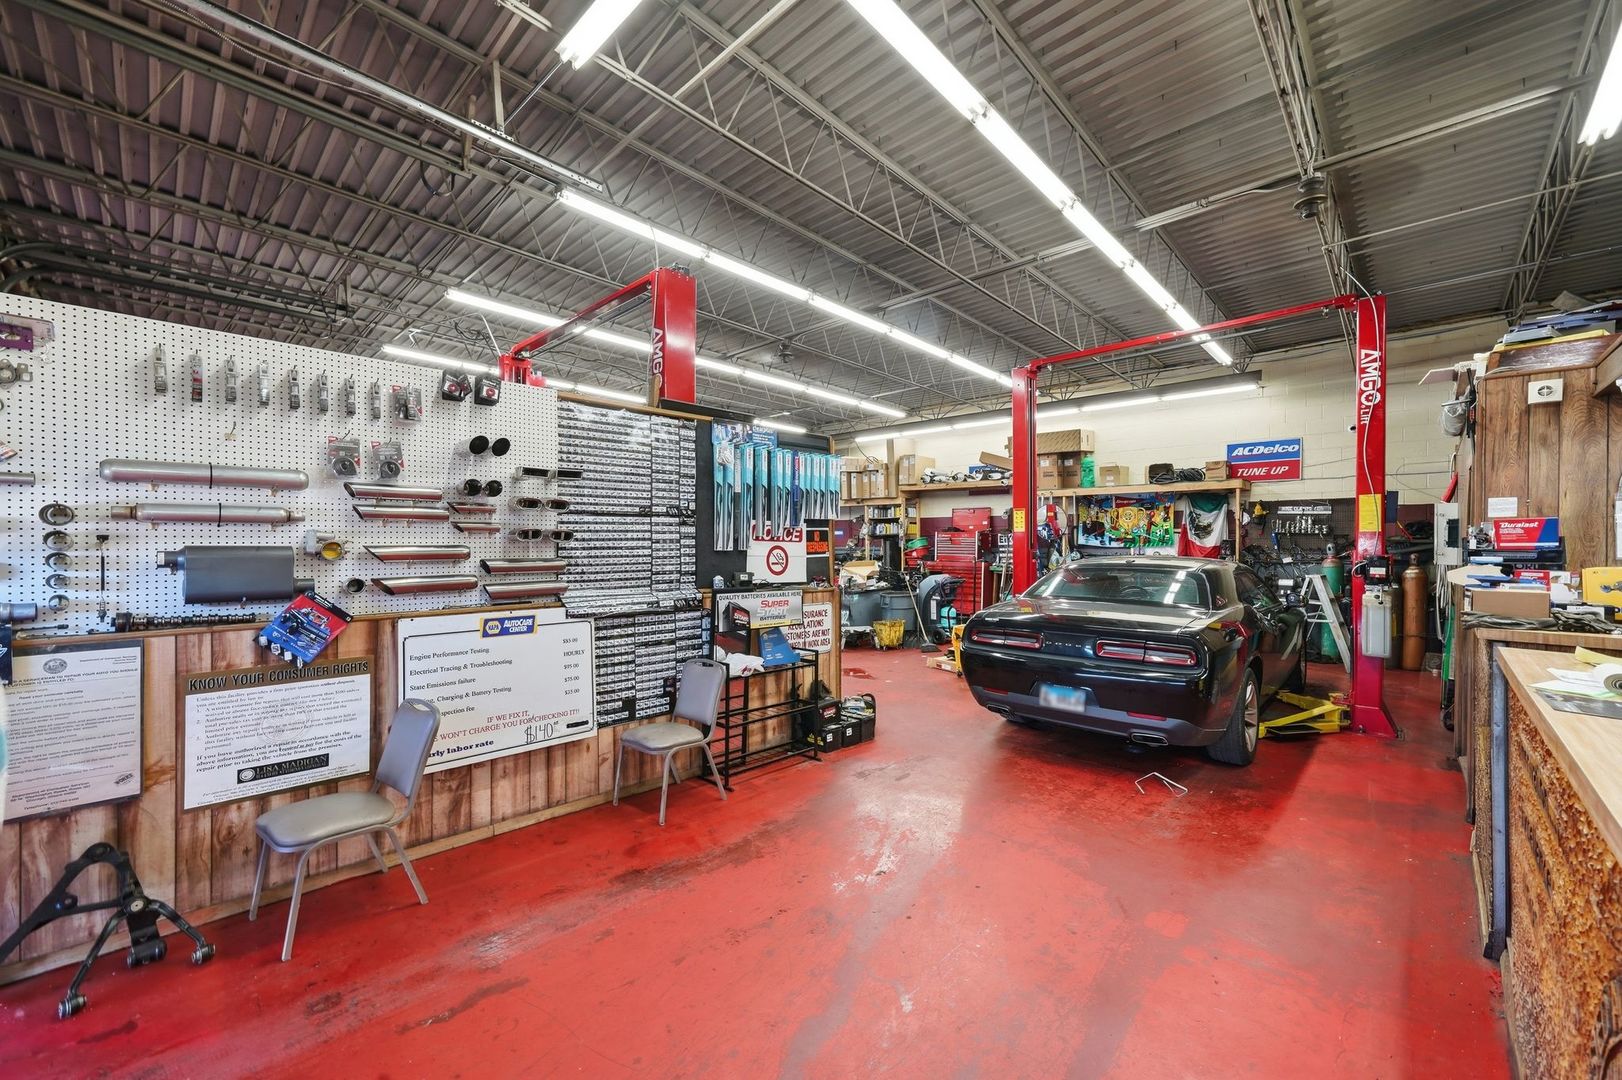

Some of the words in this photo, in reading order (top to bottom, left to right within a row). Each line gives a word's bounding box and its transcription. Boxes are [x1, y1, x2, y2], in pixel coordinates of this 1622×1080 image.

[1232, 444, 1300, 457] ACDelco
[1237, 467, 1268, 477] TUNE
[1271, 466, 1289, 475] UP
[760, 600, 789, 608] SUPER
[756, 608, 788, 616] START
[803, 609, 828, 619] SURANCE
[786, 630, 811, 640] STOMERS
[812, 629, 821, 638] ARE
[821, 629, 830, 637] NOT
[409, 654, 431, 662] Engine
[432, 649, 469, 658] Performance
[470, 647, 490, 655] Testing
[563, 649, 585, 657] HOURLY
[409, 667, 438, 676] Electrical
[439, 664, 461, 673] Tracing
[469, 658, 513, 668] Troubleshooting
[189, 676, 227, 691] KNOW
[231, 673, 265, 685] YOUR
[269, 666, 329, 681] CONSUMER
[332, 661, 368, 675] RIGHTS
[409, 684, 425, 692] State
[426, 680, 457, 689] Emissions
[457, 677, 476, 685] failure
[436, 693, 464, 703] Charging
[471, 689, 491, 698] Battery
[493, 686, 512, 695] Testing
[439, 708, 465, 718] spection
[466, 705, 475, 713] fee
[486, 716, 494, 724] IF
[508, 712, 519, 720] FIX
[440, 727, 468, 741] WON'T
[469, 724, 500, 737] CHARGE
[502, 720, 518, 730] YOU
[518, 717, 533, 726] FOR
[533, 711, 568, 723] CHECKING
[524, 723, 553, 745] $140
[447, 742, 473, 754] labor
[475, 739, 494, 749] rate
[256, 764, 279, 775] LISA
[281, 756, 327, 770] MADIGAN
